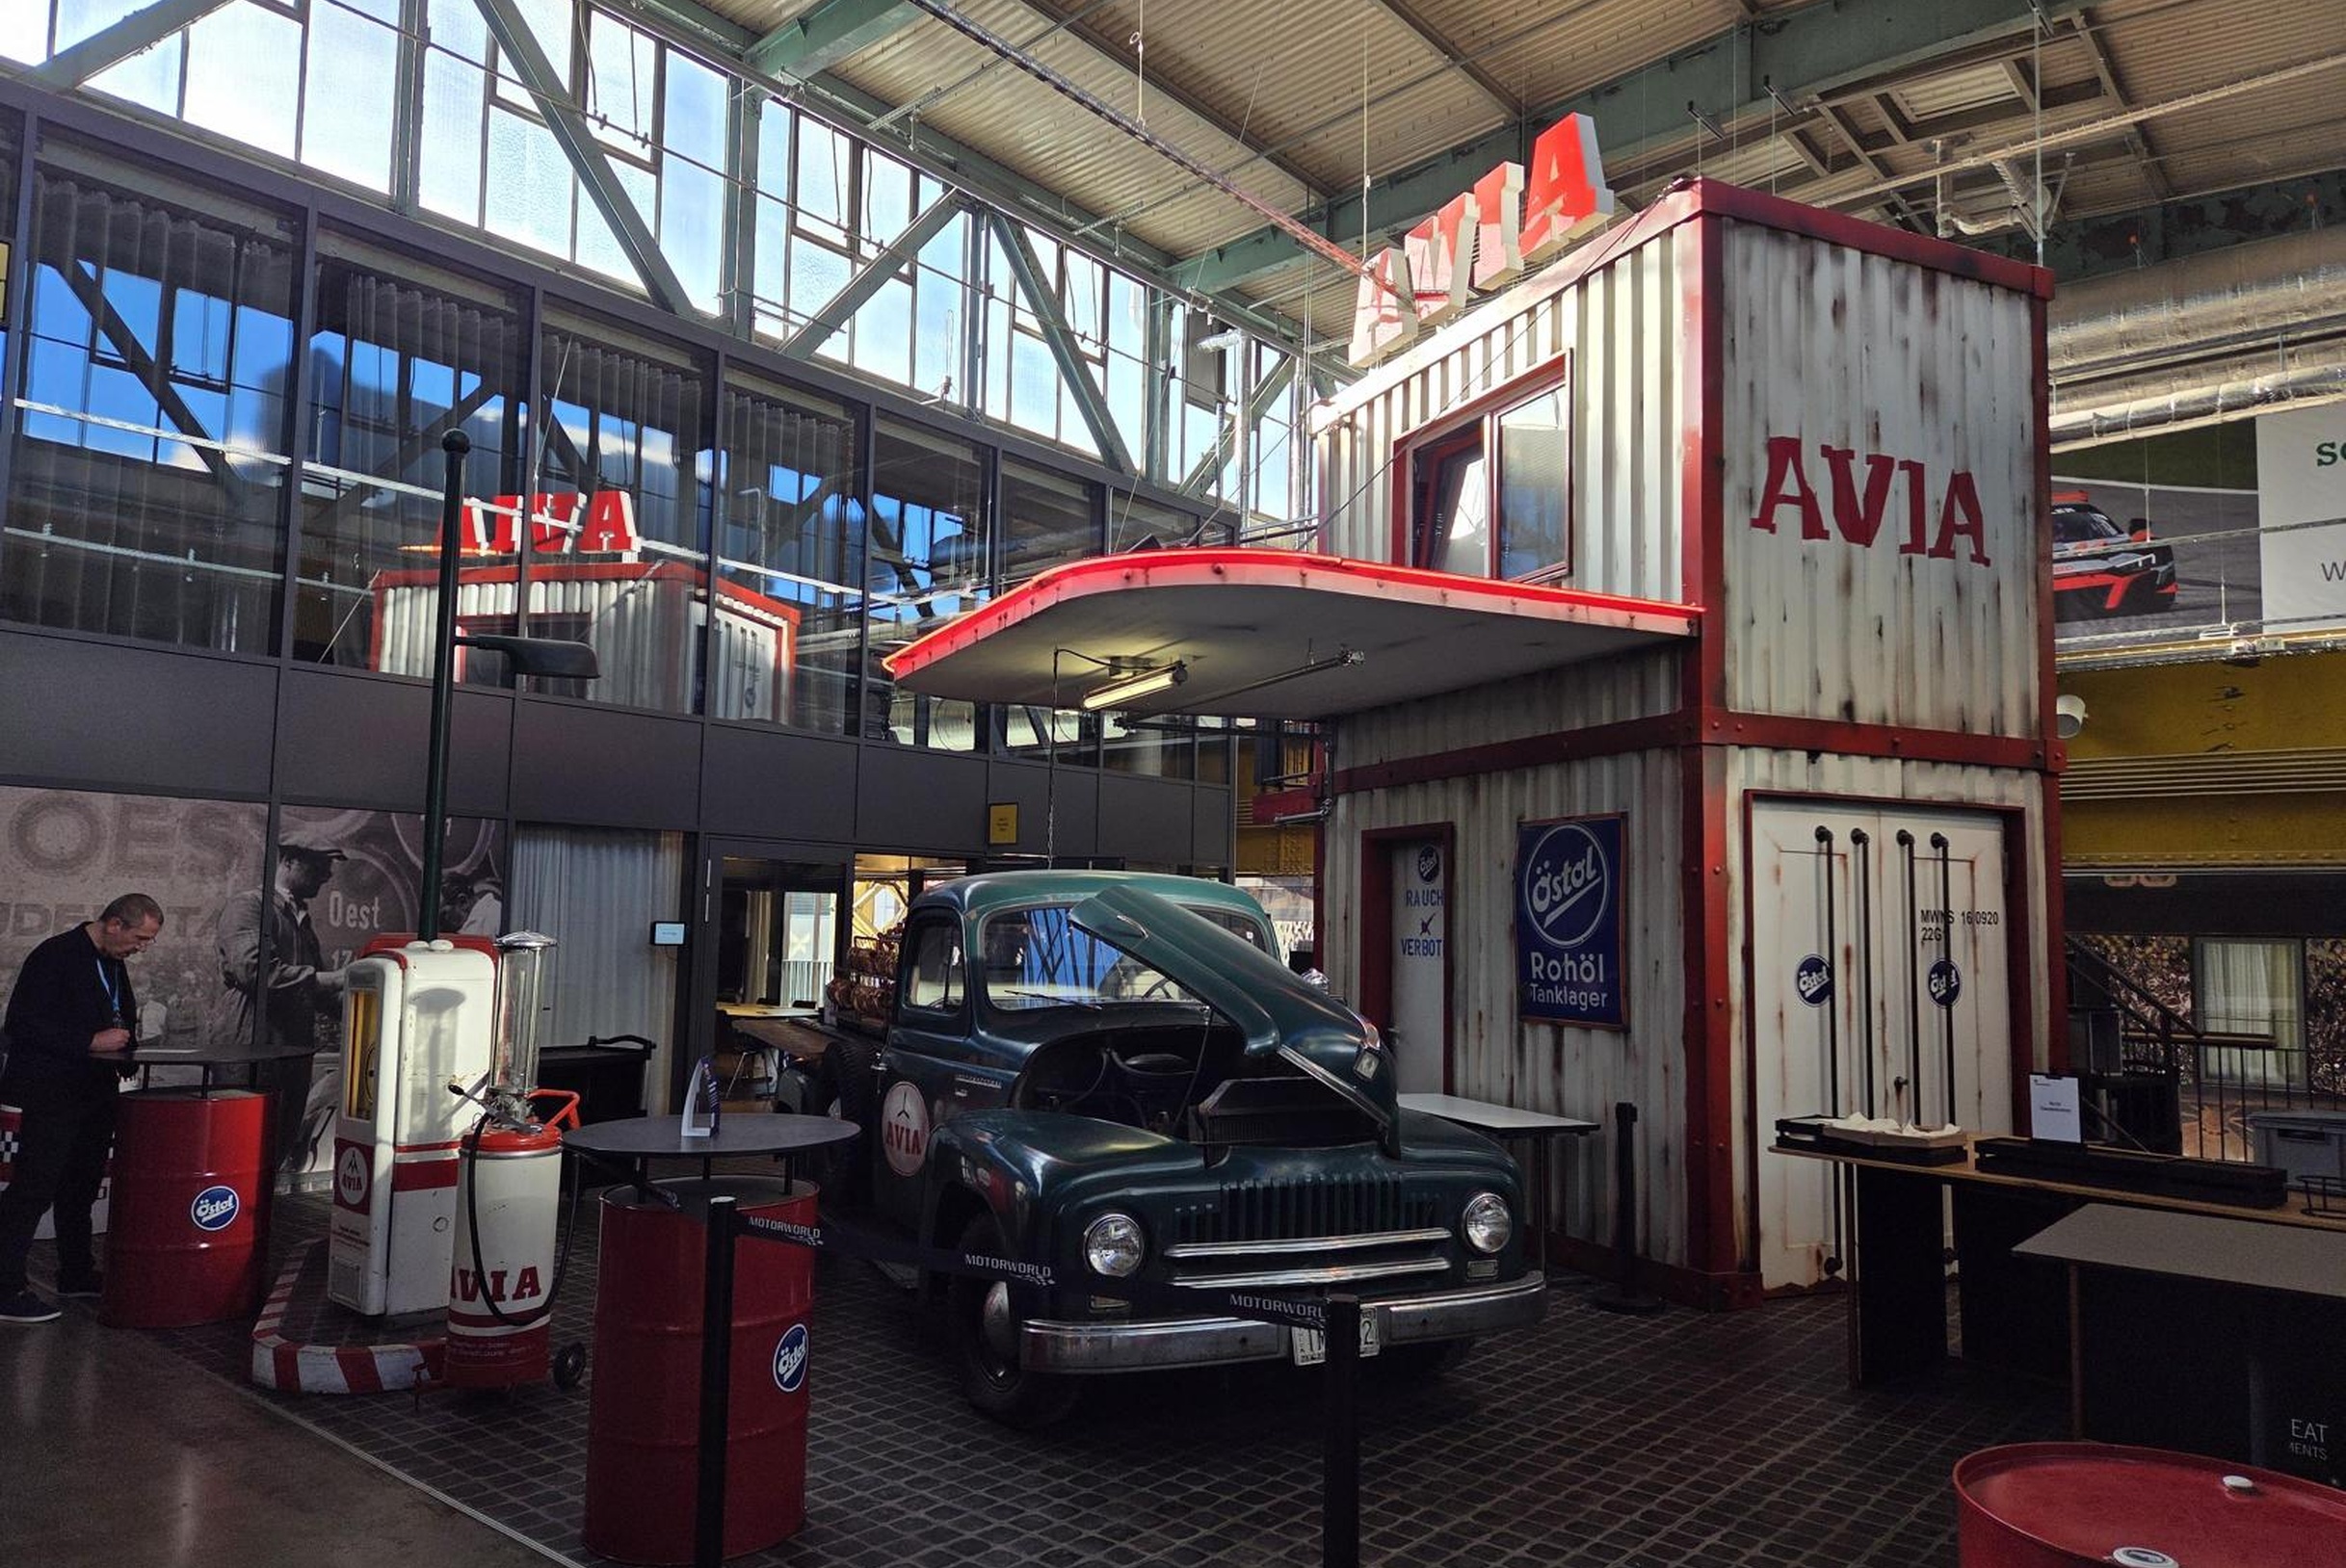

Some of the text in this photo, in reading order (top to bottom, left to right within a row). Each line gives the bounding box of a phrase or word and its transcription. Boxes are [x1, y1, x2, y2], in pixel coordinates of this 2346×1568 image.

[1349, 112, 1601, 367] AVIA
[1750, 436, 1990, 567] AVIA
[1532, 845, 1597, 912] Östol
[329, 890, 381, 929] Oest
[1530, 952, 1604, 983] Rohöl
[1530, 983, 1608, 1012] Tanklager
[886, 1121, 921, 1155] AVIA
[196, 1194, 234, 1217] Östol
[748, 1216, 821, 1239] MOTORWORLD
[964, 1254, 1051, 1278] MOTORWORLD
